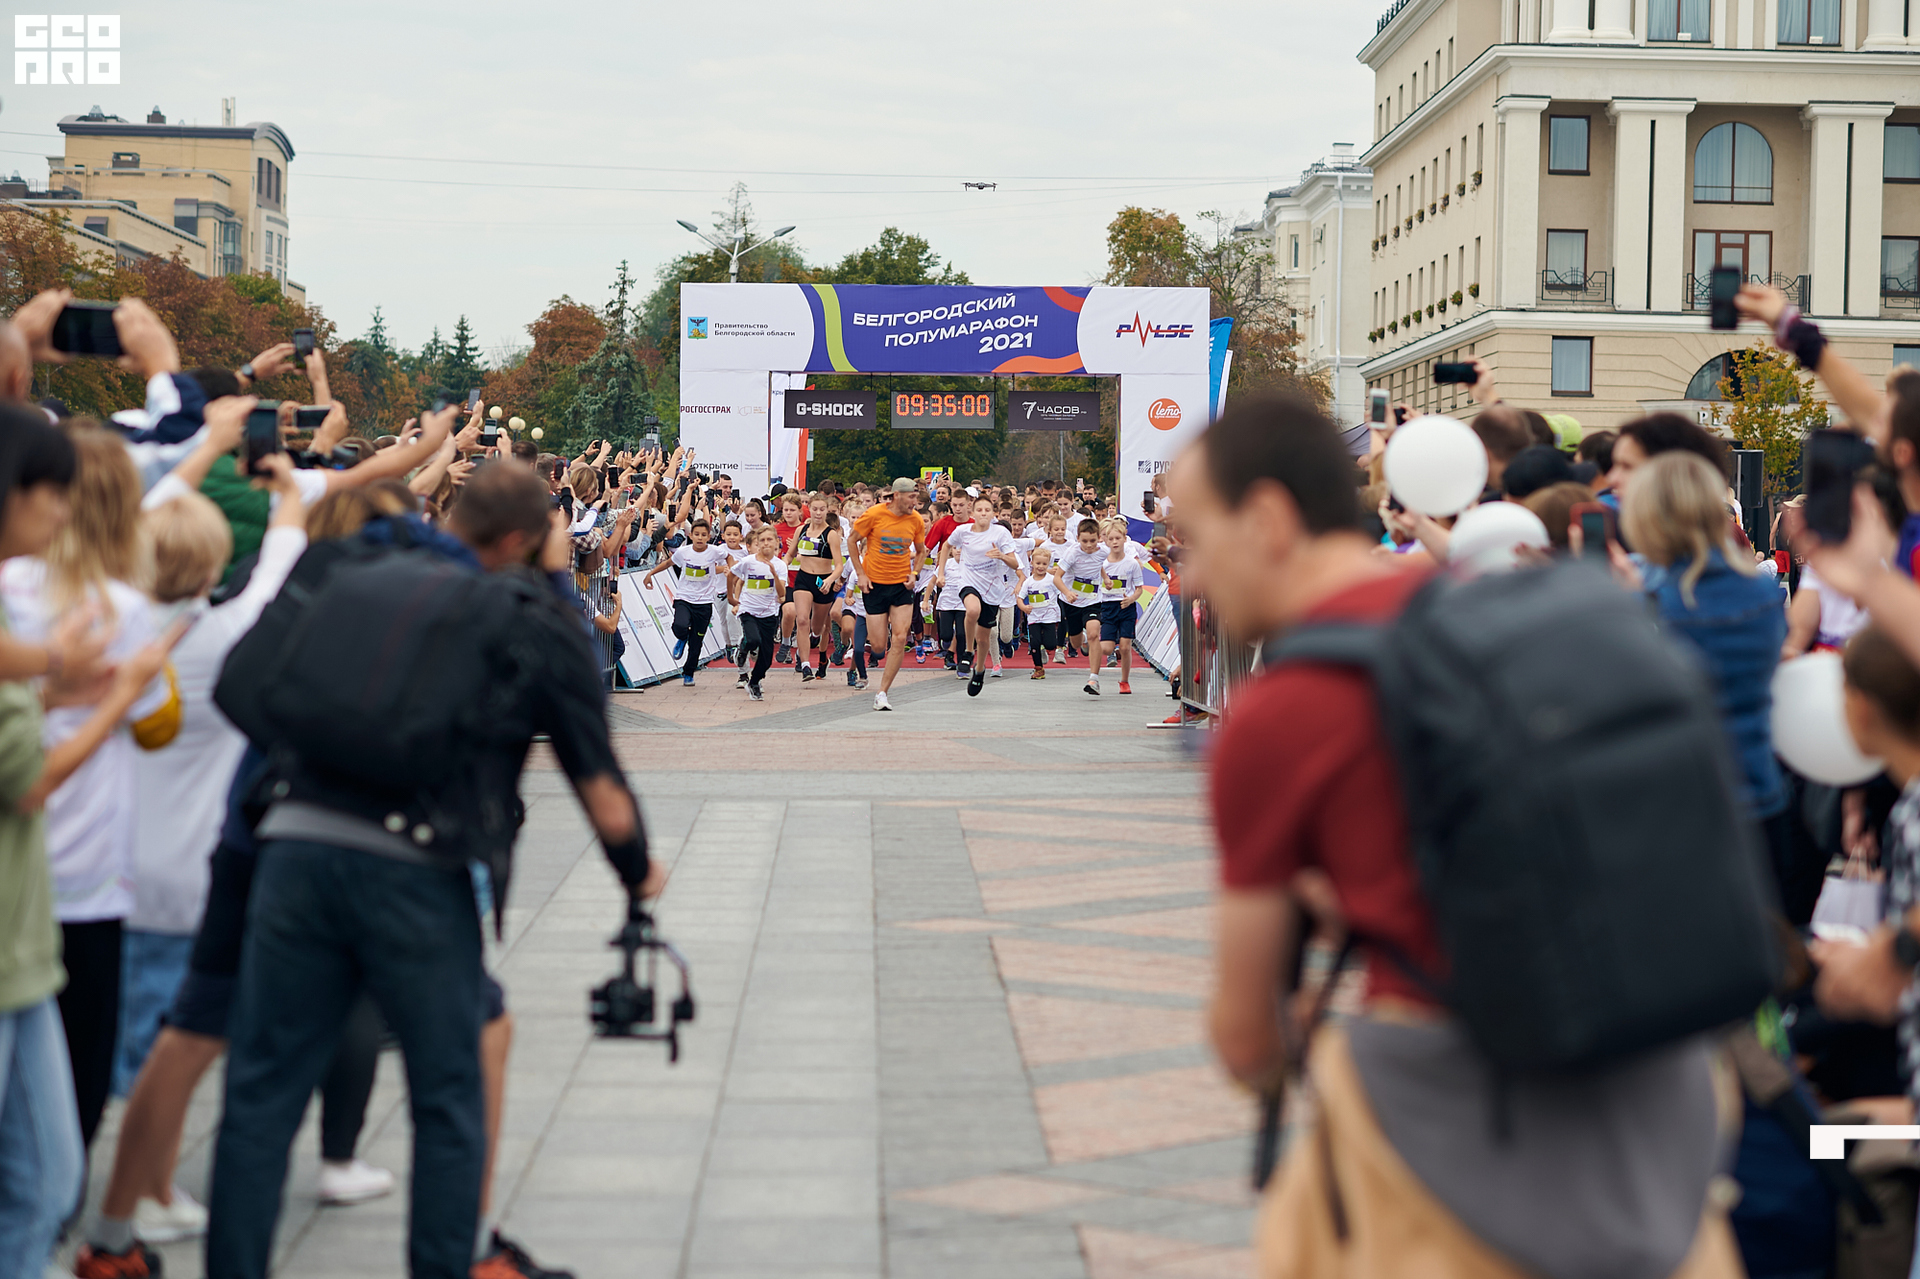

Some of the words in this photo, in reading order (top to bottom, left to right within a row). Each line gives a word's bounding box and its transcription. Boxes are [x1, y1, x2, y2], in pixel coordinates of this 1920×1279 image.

[853, 293, 1016, 327] БЕЛГОРОДСКИЙ
[884, 314, 1039, 348] ПОЛУМАРАФОН
[978, 332, 1033, 354] 2021
[680, 405, 732, 414] РОСГОССТРАХ
[796, 402, 864, 416] G-SHOCK
[896, 394, 990, 416] 09:35:00
[1022, 401, 1037, 420] 7
[1037, 406, 1080, 414] ЧАСОВ
[693, 462, 739, 471] открытие
[692, 569, 697, 577] 1
[755, 580, 761, 589] 1
[1081, 584, 1086, 592] 1
